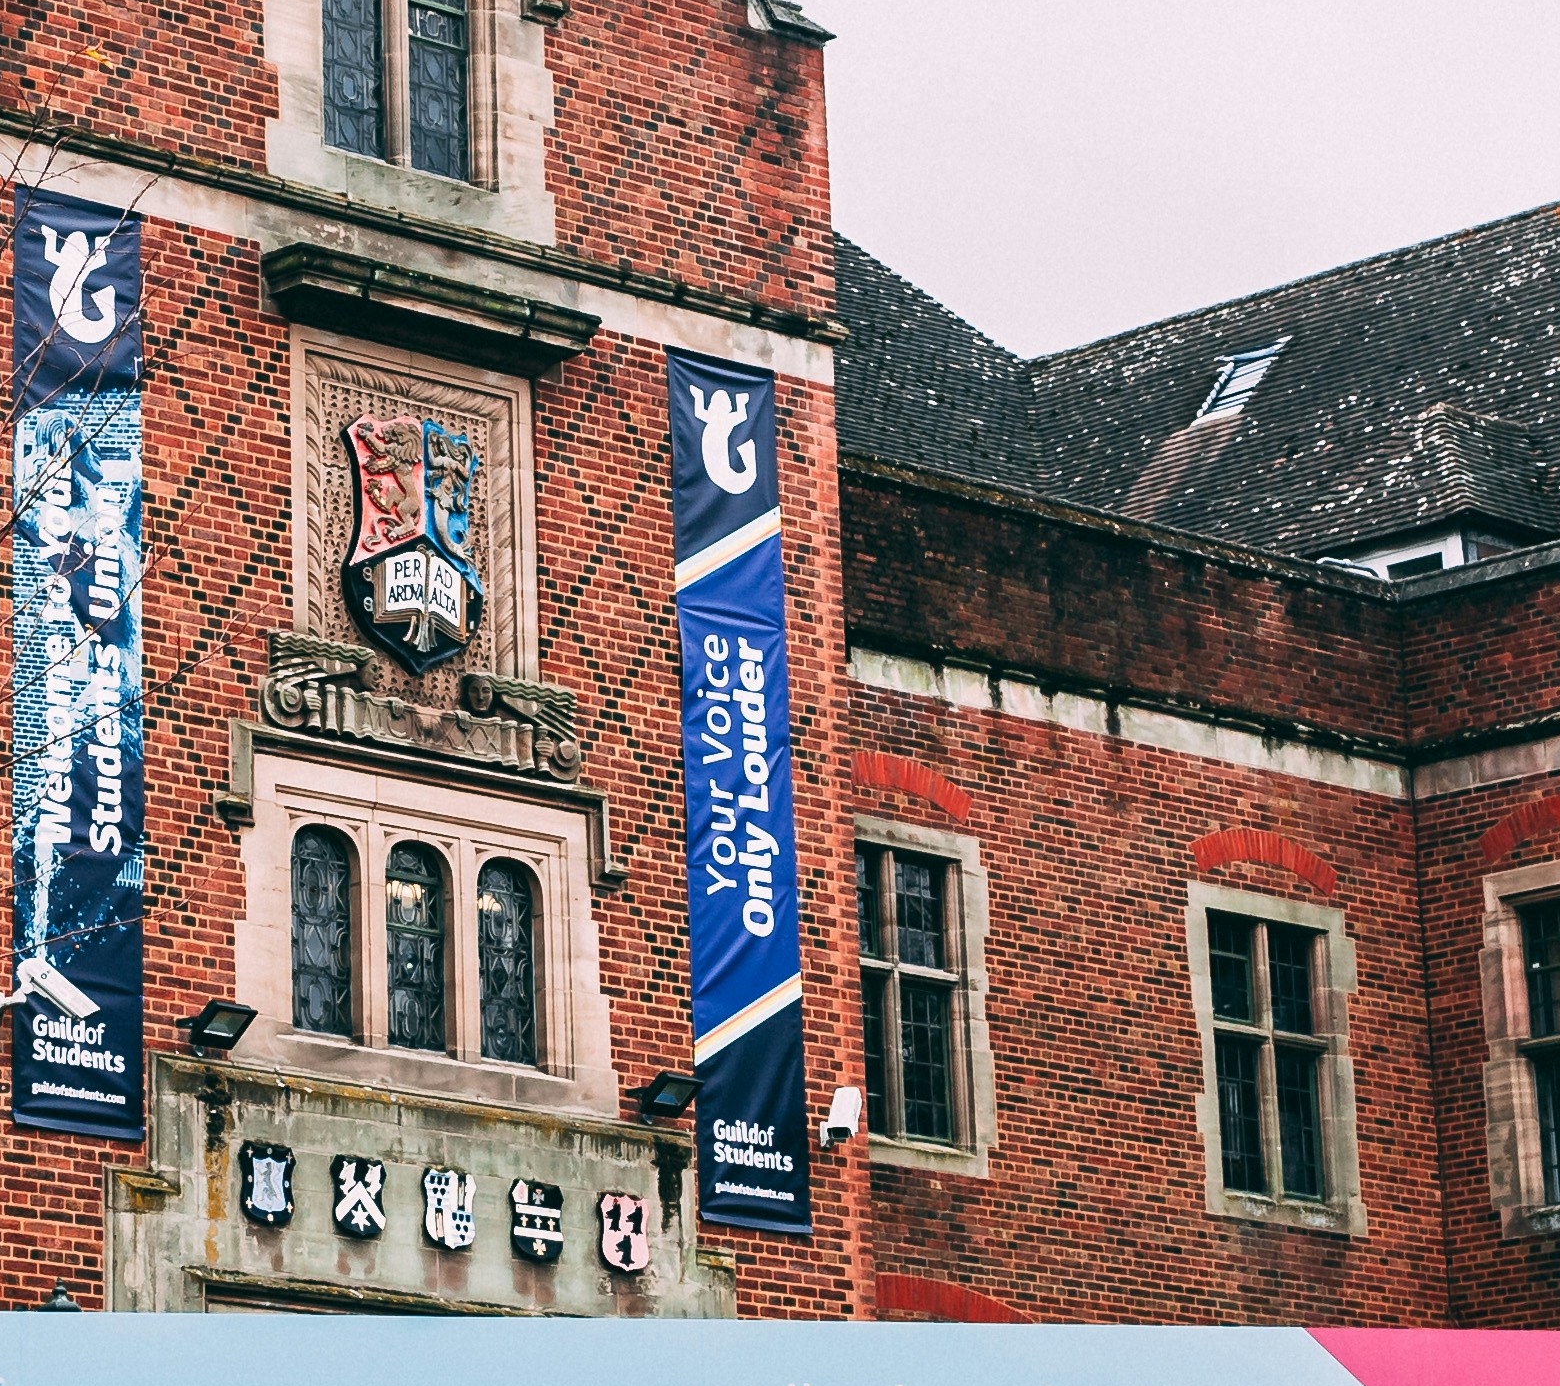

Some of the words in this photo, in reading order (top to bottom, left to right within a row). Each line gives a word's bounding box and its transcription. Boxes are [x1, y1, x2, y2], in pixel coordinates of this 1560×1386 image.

[39, 453, 73, 560] Your
[84, 487, 121, 620] Union
[394, 558, 423, 580] PER
[42, 576, 73, 620] to
[434, 564, 453, 589] AD
[429, 587, 458, 619] ALTA
[697, 633, 732, 764] Voice
[39, 634, 73, 845] Welcome
[733, 636, 769, 813] Louder
[706, 778, 737, 896] Your
[739, 821, 779, 938] Only
[32, 1038, 126, 1073] Students
[31, 1080, 126, 1105] guildofstudents.com
[713, 1141, 794, 1172] Students
[715, 1181, 795, 1202] guildofstudents.com
